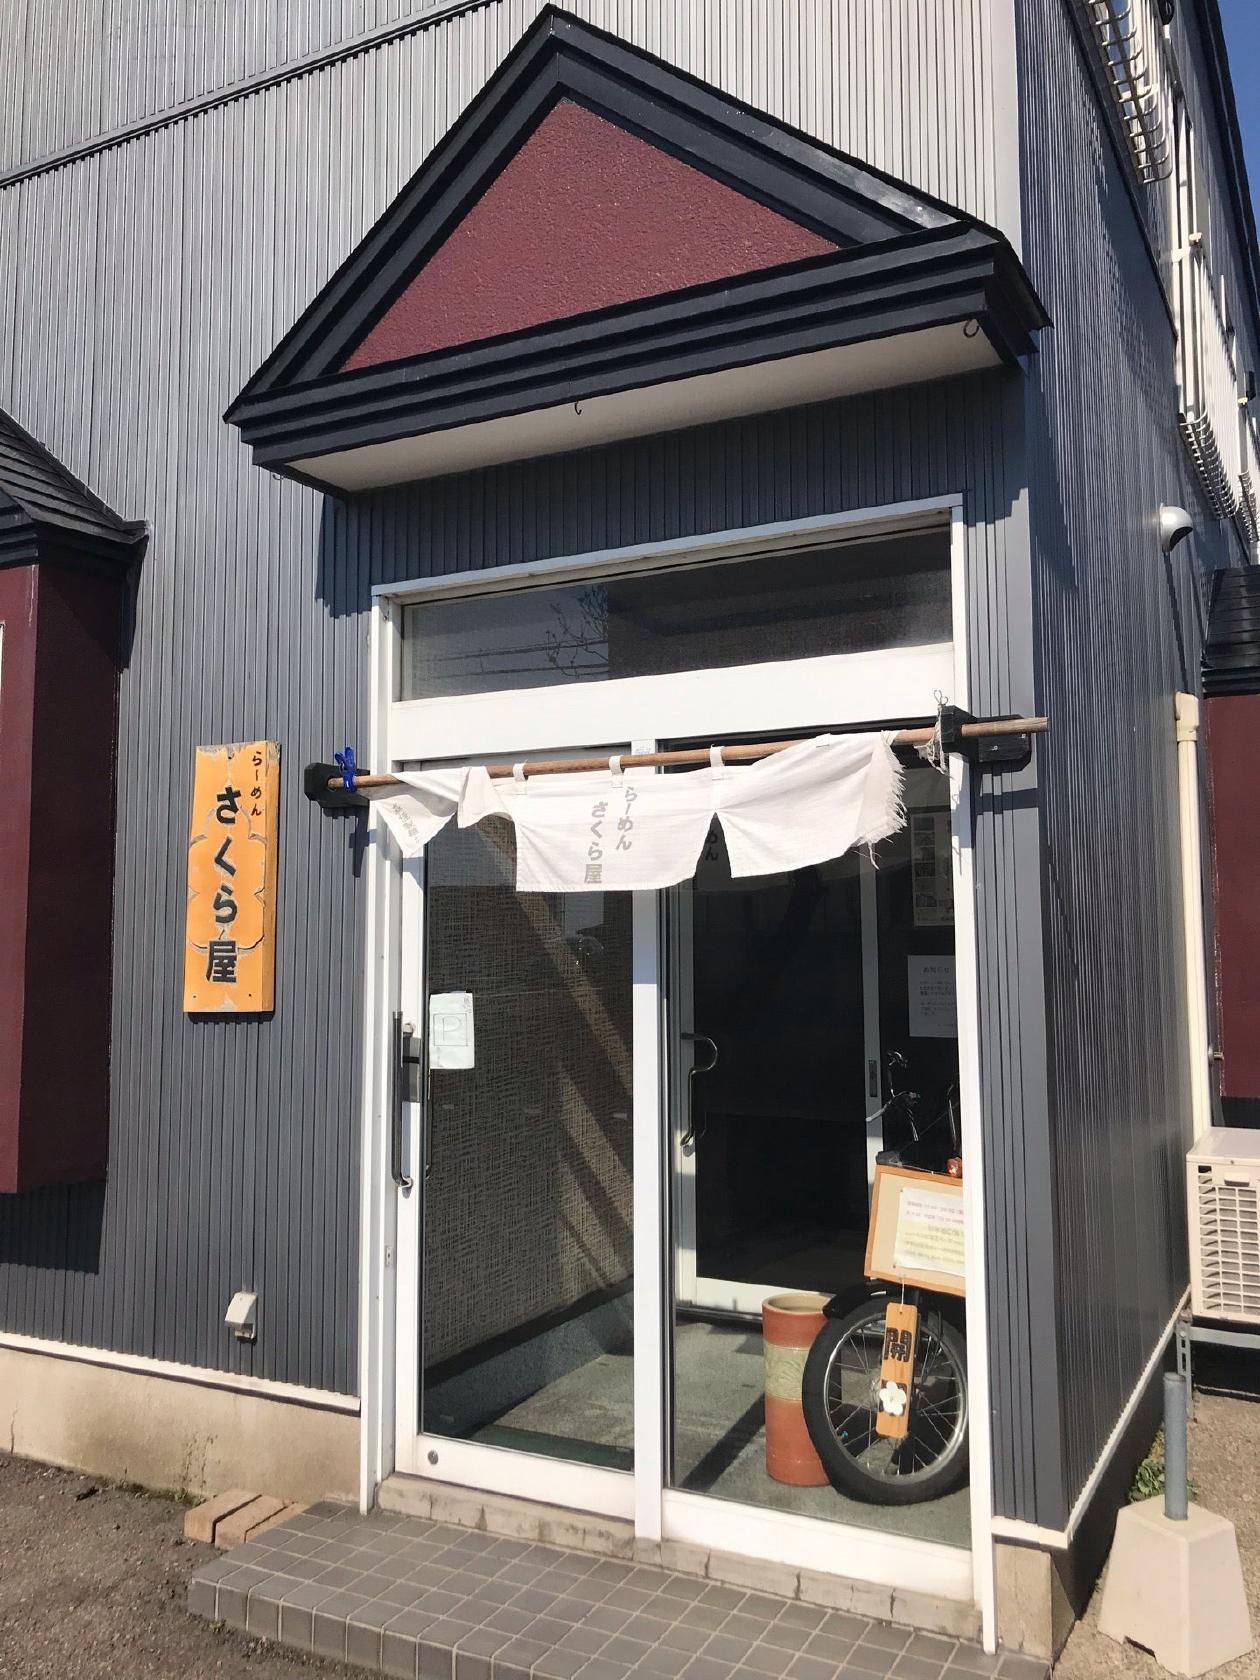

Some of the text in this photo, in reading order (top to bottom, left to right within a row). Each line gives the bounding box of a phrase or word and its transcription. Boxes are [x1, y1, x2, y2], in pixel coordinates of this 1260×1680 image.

[250, 751, 263, 817] らーめん
[616, 786, 638, 851] らーめん
[584, 801, 609, 884] さくら屋
[206, 786, 242, 983] さくら屋
